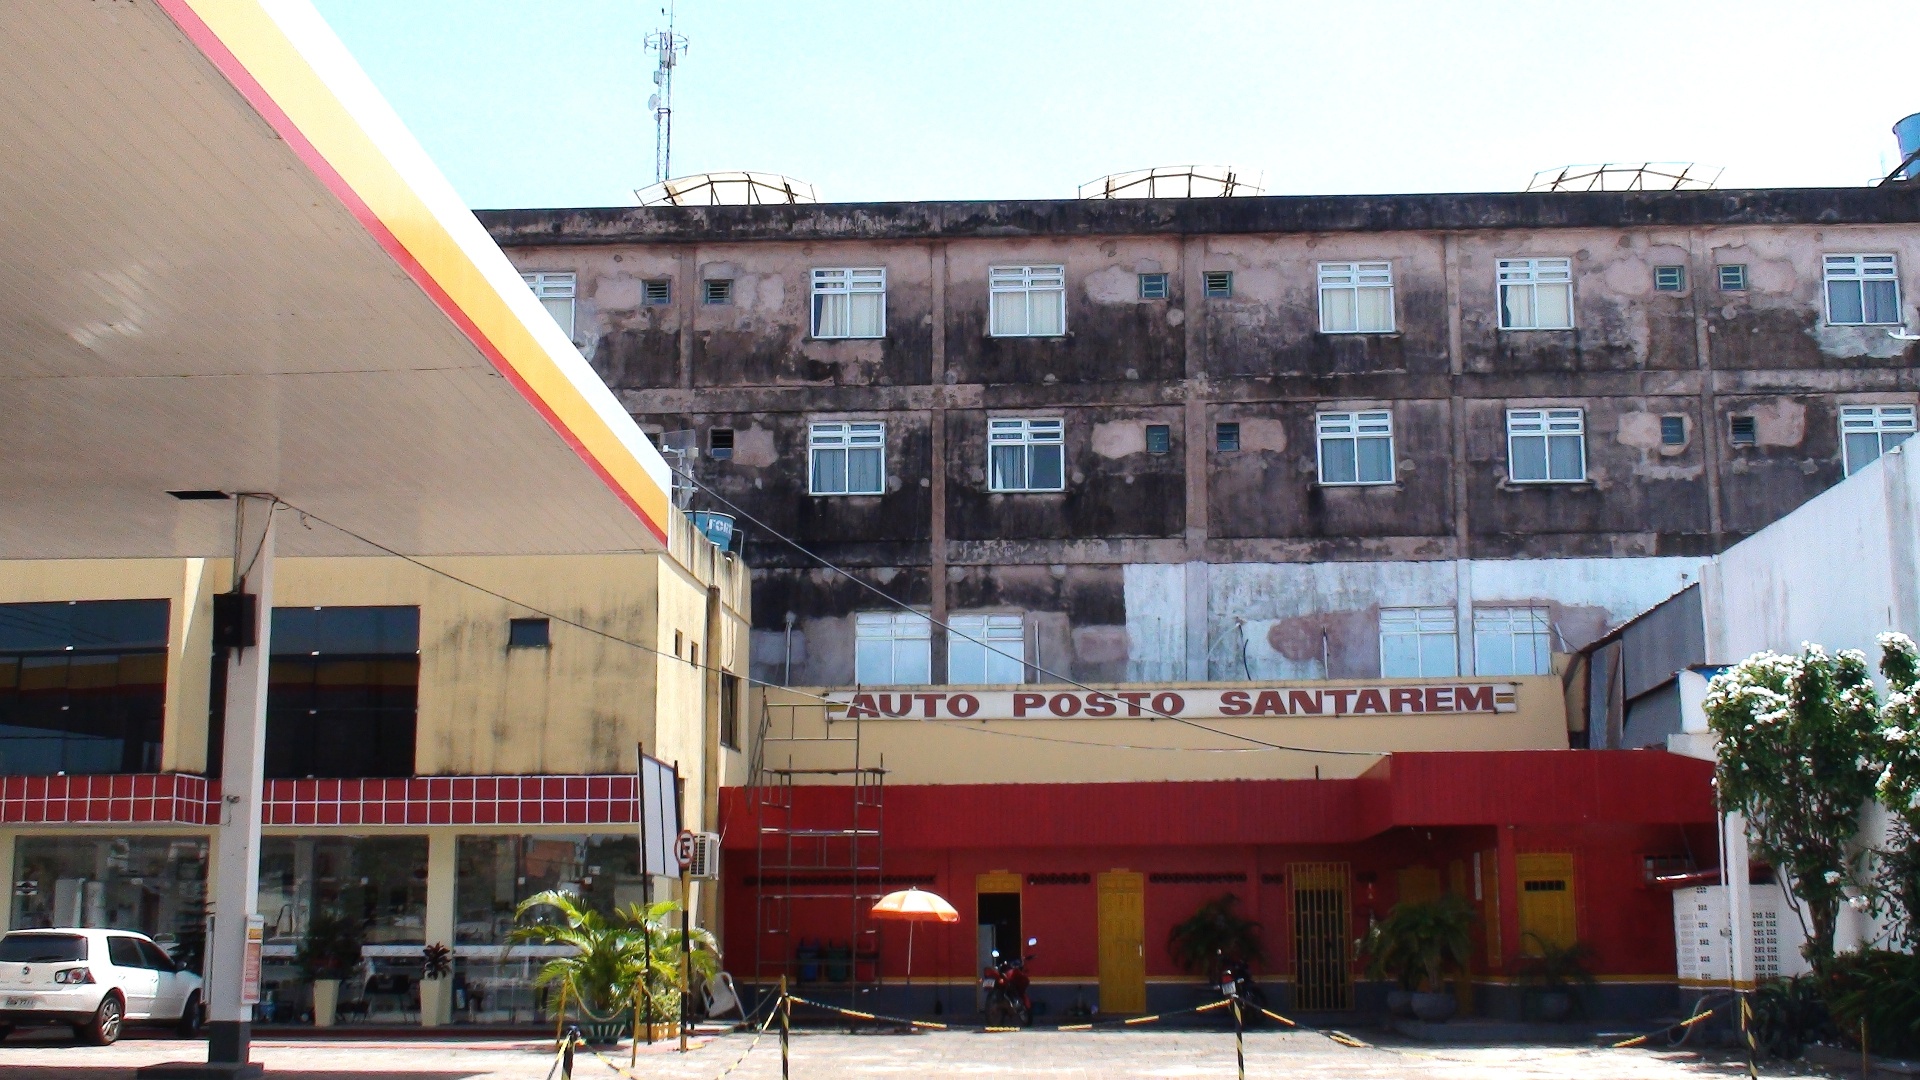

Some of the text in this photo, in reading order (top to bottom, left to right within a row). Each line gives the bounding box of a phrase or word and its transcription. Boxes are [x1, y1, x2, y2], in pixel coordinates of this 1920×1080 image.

[846, 686, 1494, 718] AUTO POSTO SANTAREM
